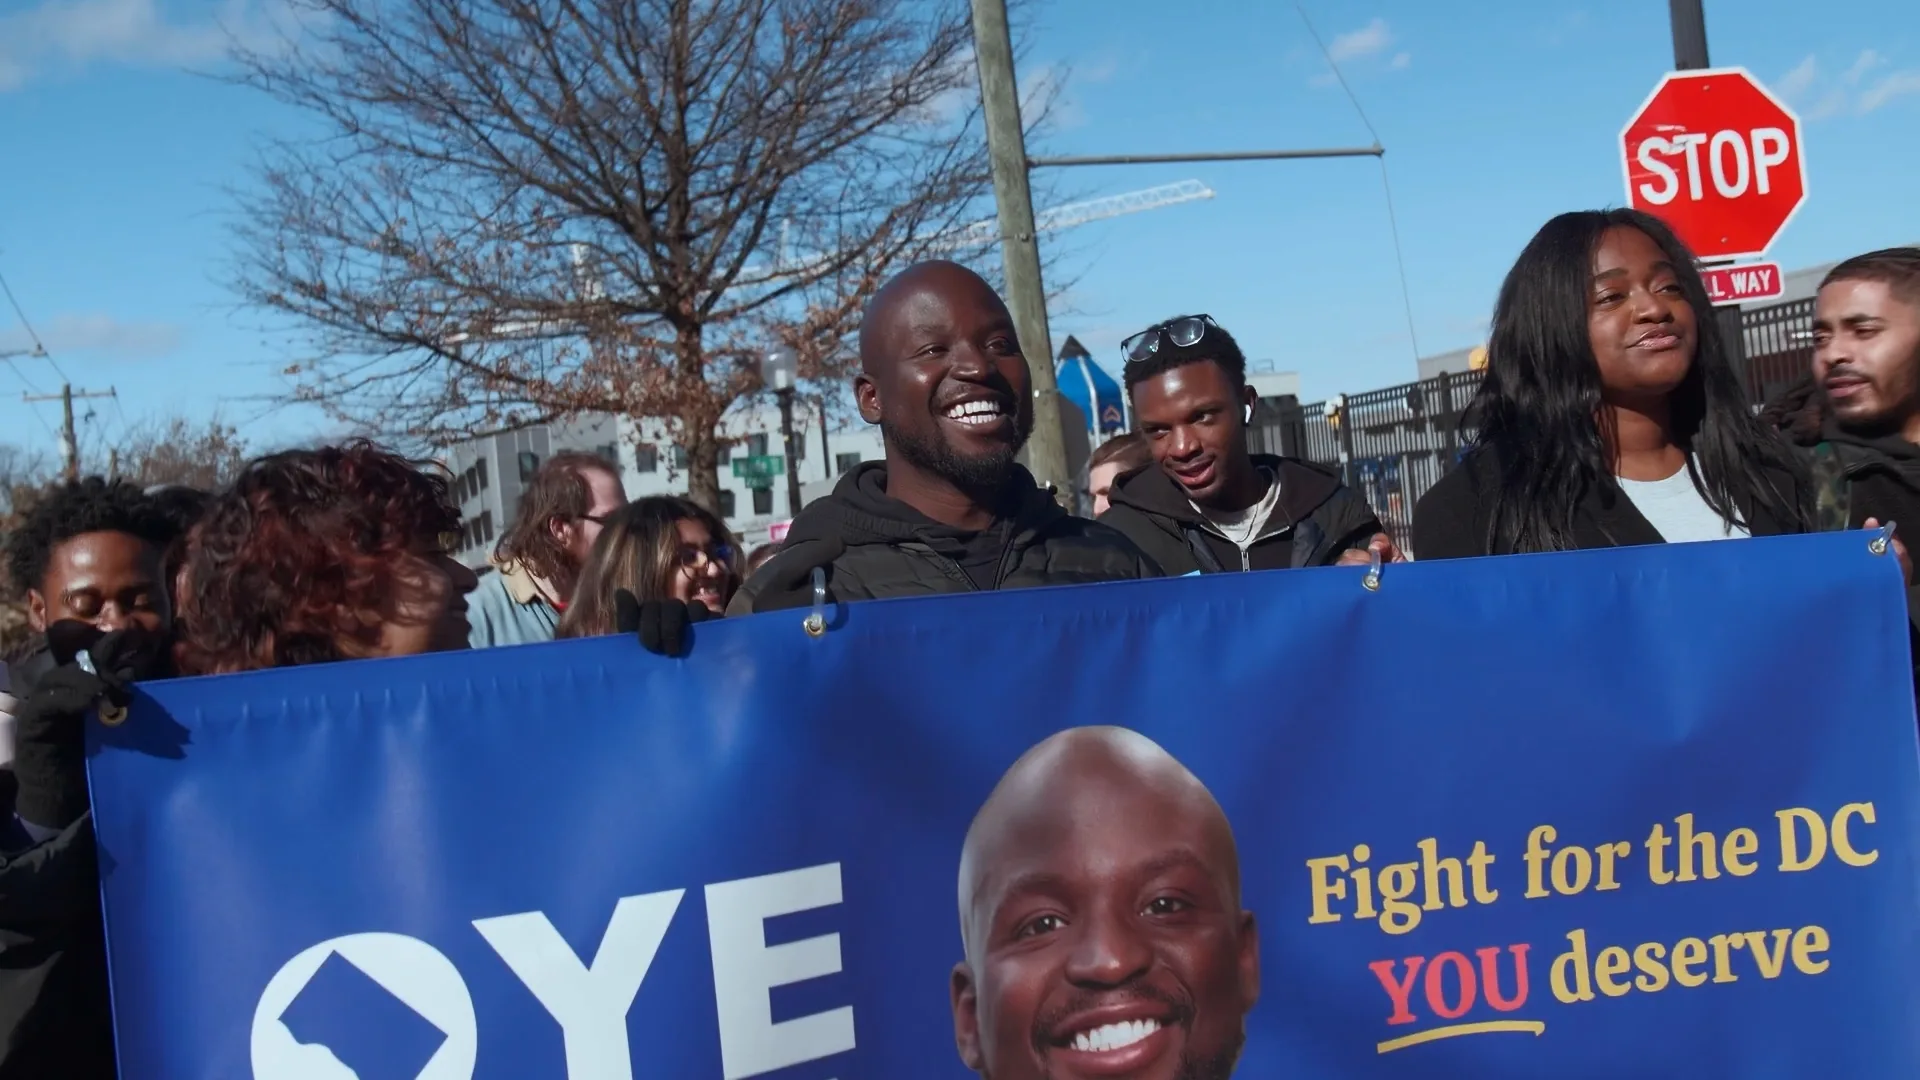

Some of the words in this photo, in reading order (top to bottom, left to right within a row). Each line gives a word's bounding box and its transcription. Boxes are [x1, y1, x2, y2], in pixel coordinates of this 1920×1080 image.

[1637, 128, 1789, 205] STOP
[1730, 269, 1771, 294] WAY
[1306, 837, 1498, 935] Fight
[1523, 825, 1631, 899] for
[1645, 813, 1759, 885] the
[1775, 802, 1879, 872] DC
[250, 861, 856, 1080] OYE
[1369, 943, 1530, 1025] YOU
[1550, 925, 1830, 1004] deserve
